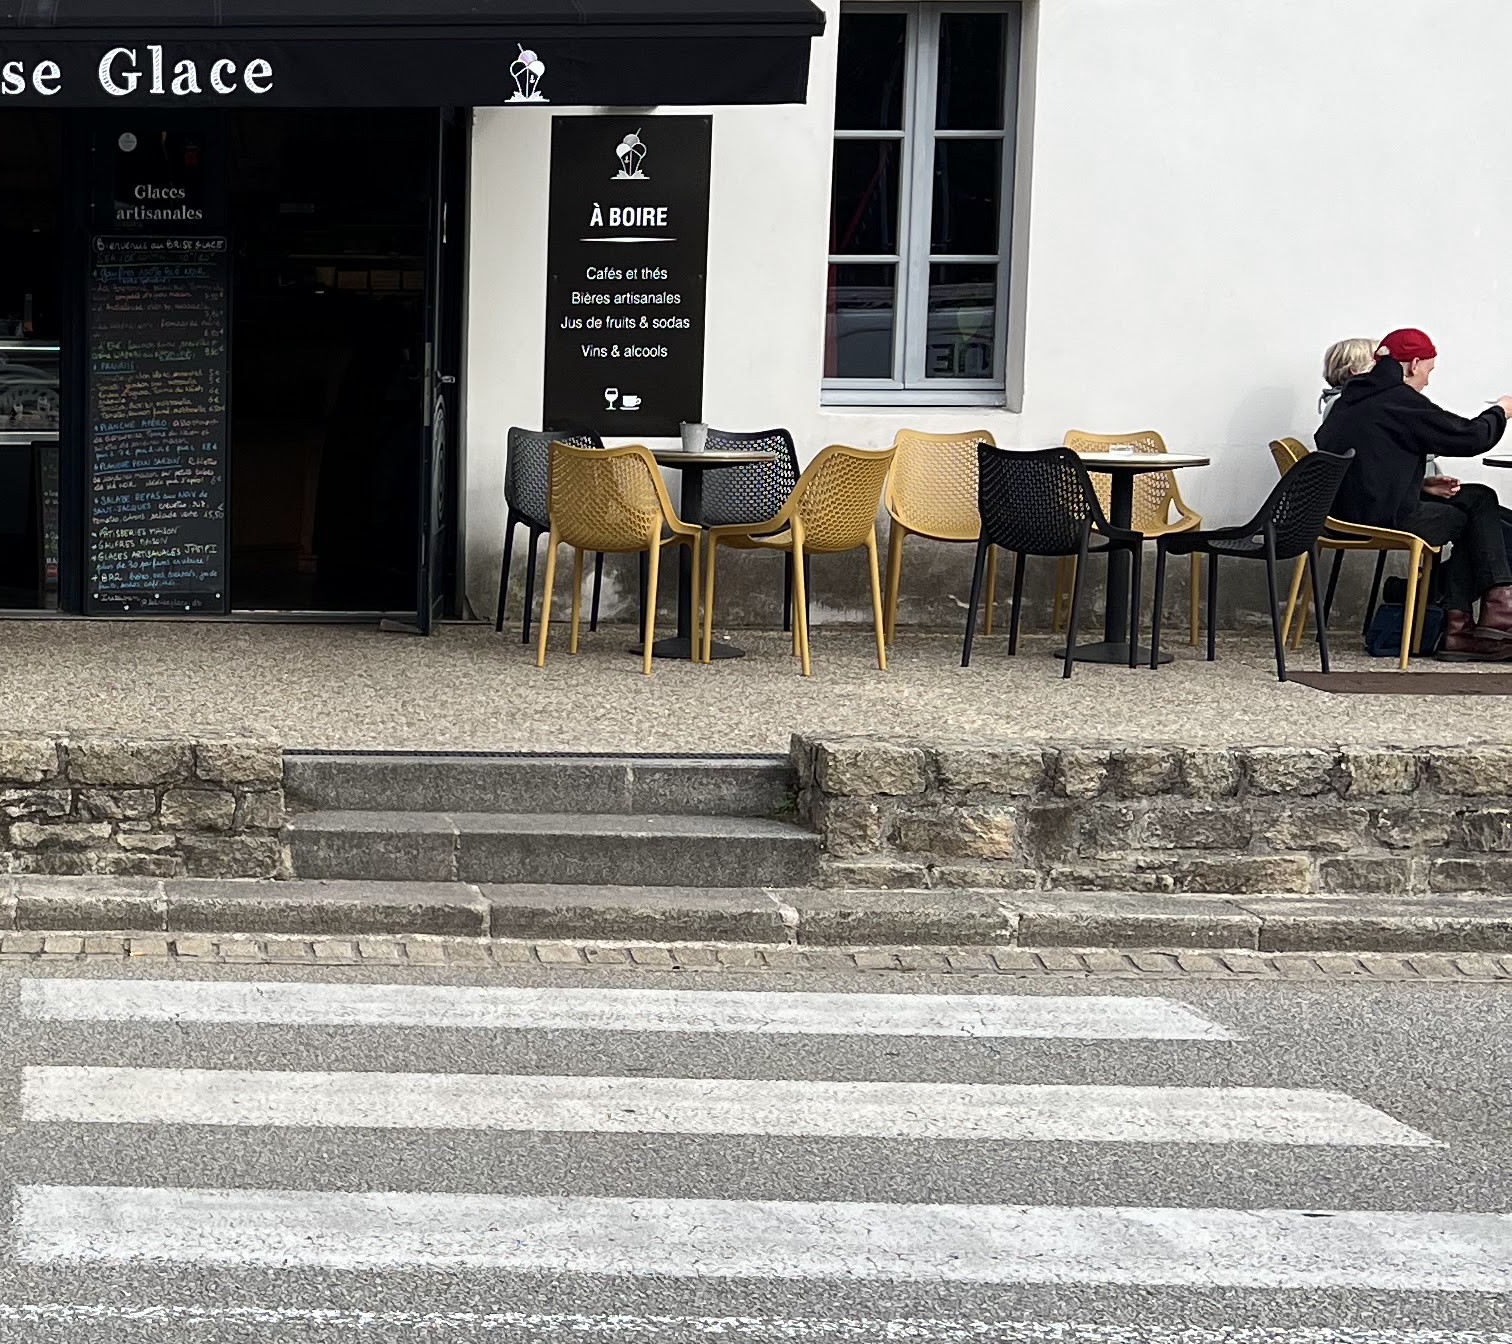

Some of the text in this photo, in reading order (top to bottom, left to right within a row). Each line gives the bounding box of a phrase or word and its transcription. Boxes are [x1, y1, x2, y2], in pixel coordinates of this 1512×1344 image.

[97, 44, 274, 97] Glace
[134, 184, 186, 199] Glaces
[116, 204, 203, 220] artisanales
[589, 202, 668, 227] À BOIRE
[586, 266, 668, 281] Cafés et thés
[571, 291, 681, 306] Bières artisanales
[560, 316, 691, 330] Jus de fruits & sodas
[581, 344, 668, 359] Vins & alcools
[100, 494, 131, 506] SALADE
[98, 551, 129, 562] GLACES
